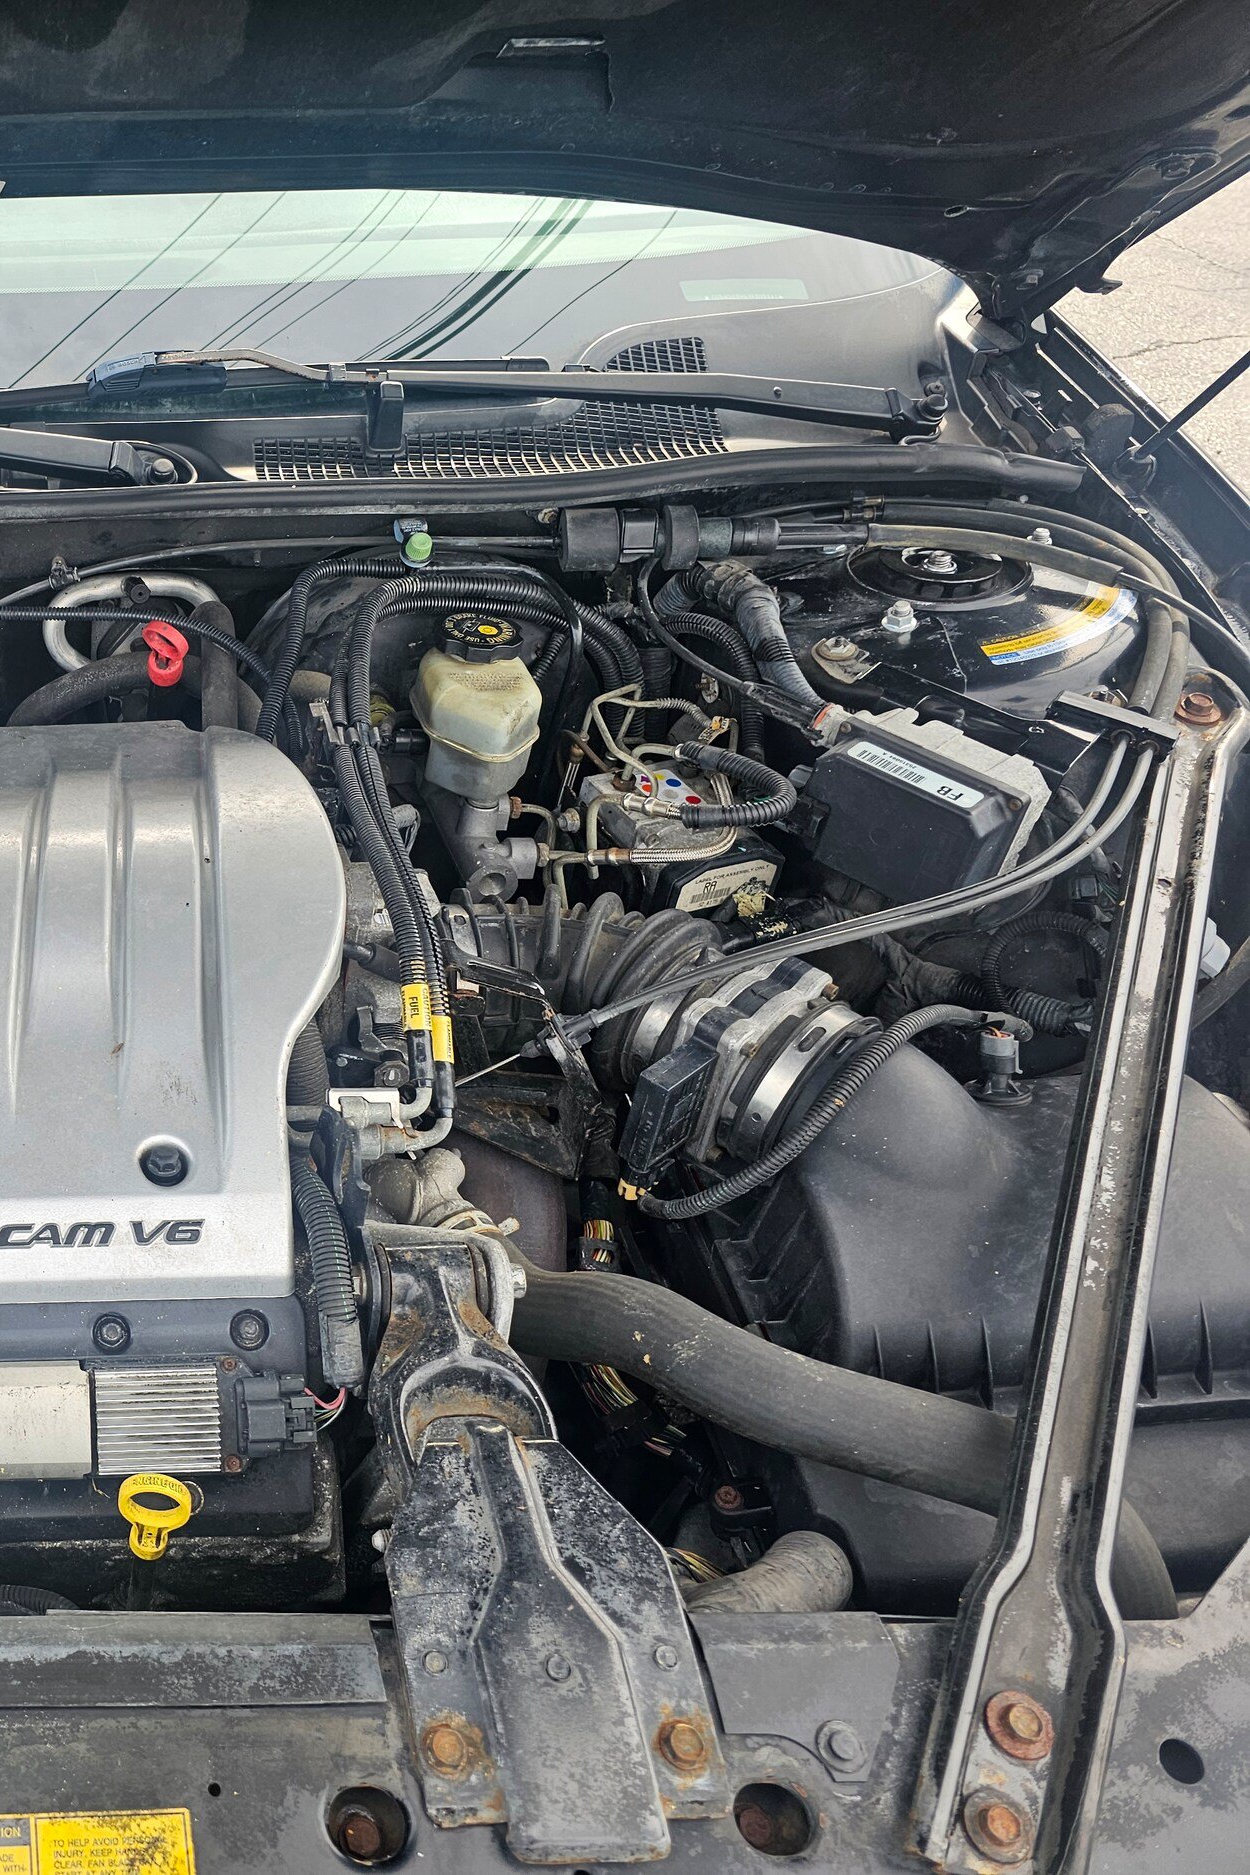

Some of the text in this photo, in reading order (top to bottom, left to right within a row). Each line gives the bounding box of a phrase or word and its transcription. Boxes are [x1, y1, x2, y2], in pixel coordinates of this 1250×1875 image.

[936, 785, 964, 802] FB
[695, 876, 712, 884] LABEL
[754, 864, 770, 872] ONLY
[408, 996, 420, 1019] FUEL
[129, 1218, 206, 1245] V6
[67, 1838, 90, 1847] HELP
[92, 1838, 119, 1846] AVOID
[90, 1848, 113, 1857] KEEP
[87, 1859, 105, 1868] FAN
